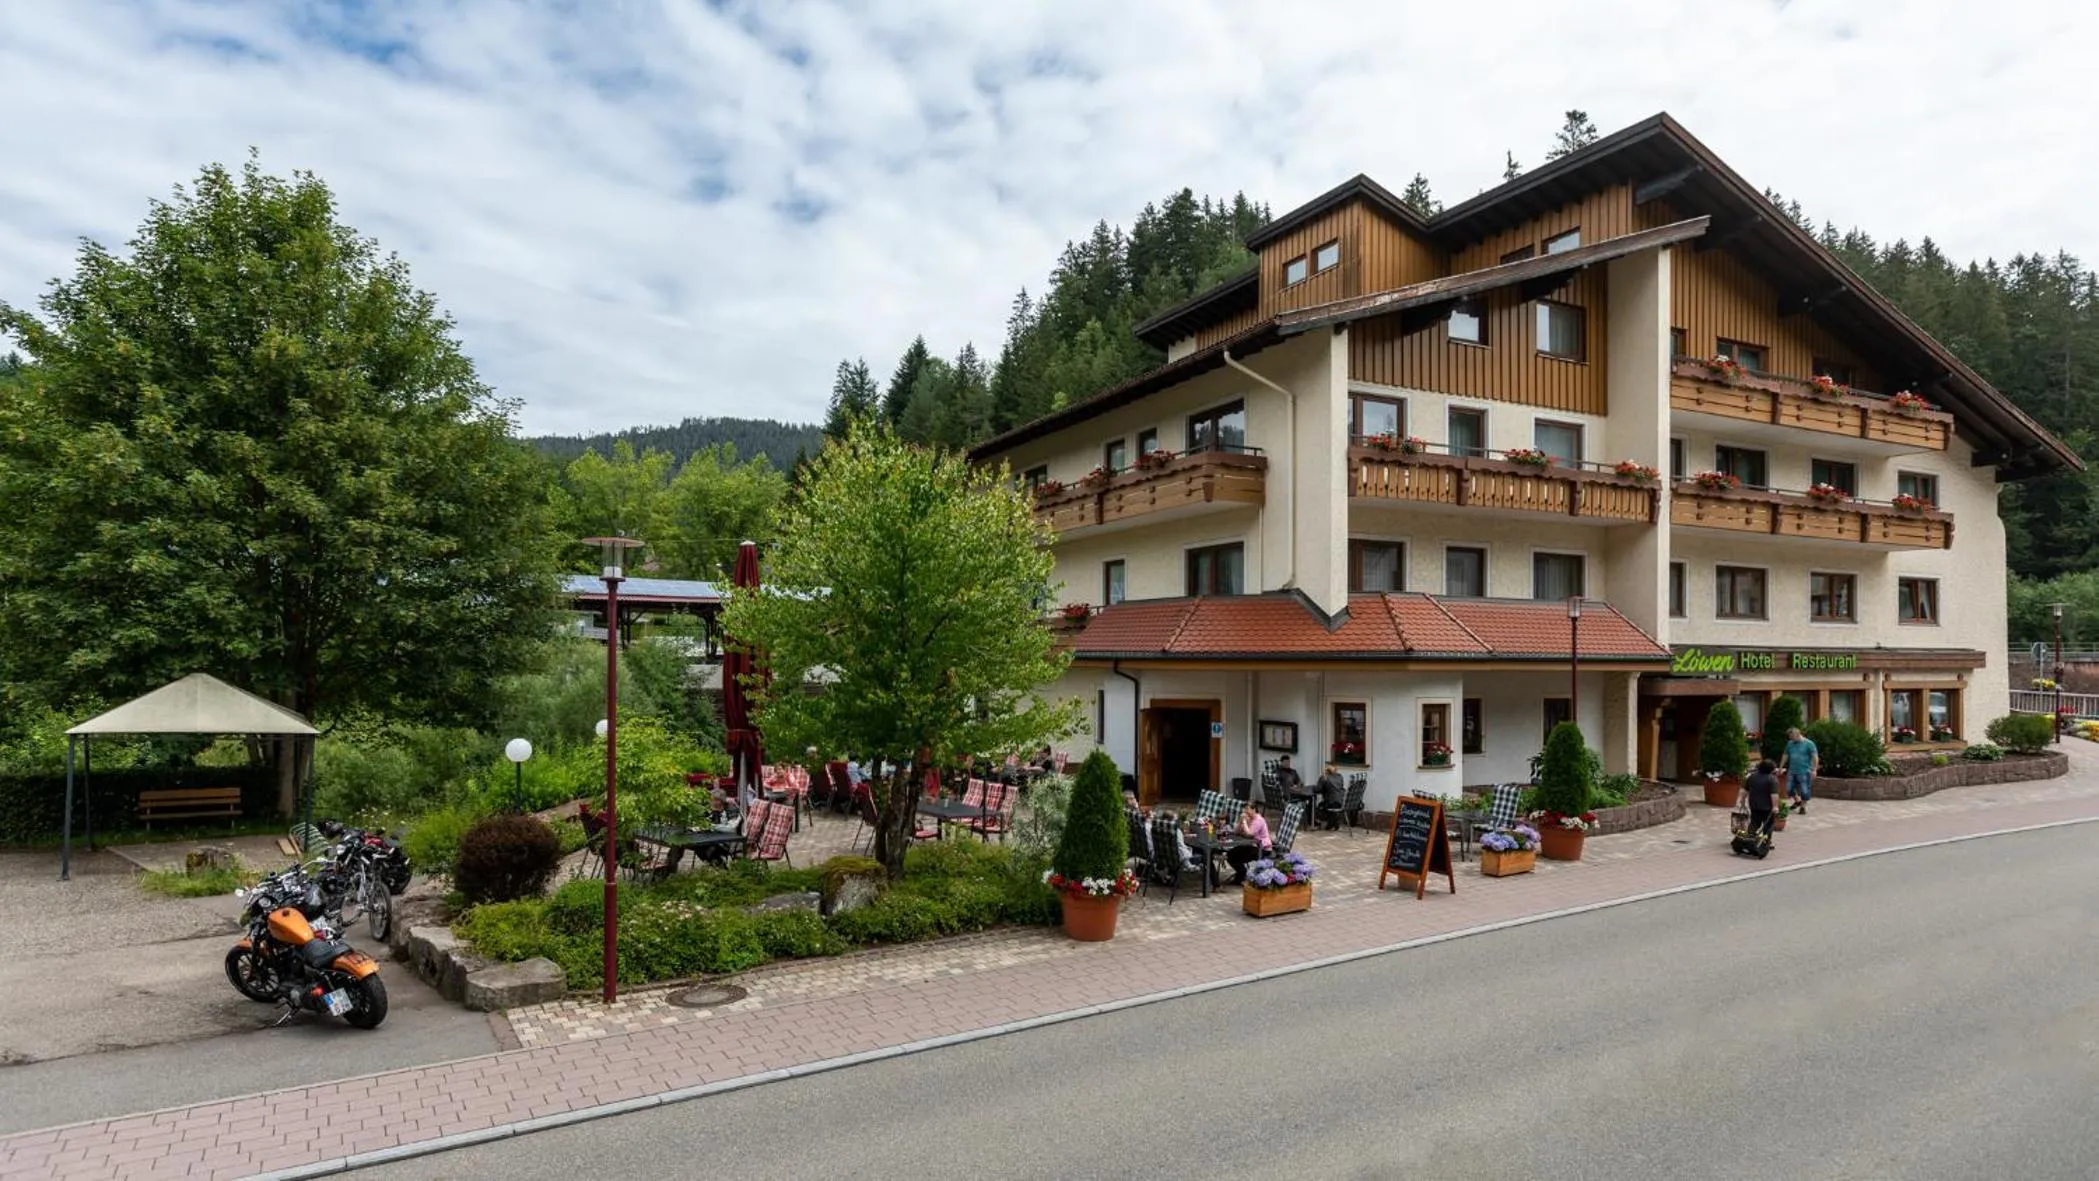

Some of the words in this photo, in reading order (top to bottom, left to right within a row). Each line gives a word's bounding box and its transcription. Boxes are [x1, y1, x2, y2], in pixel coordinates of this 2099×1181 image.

[1672, 648, 1734, 672] Löwen
[1741, 652, 1776, 669] Hotel
[1792, 653, 1857, 669] Restaurant
